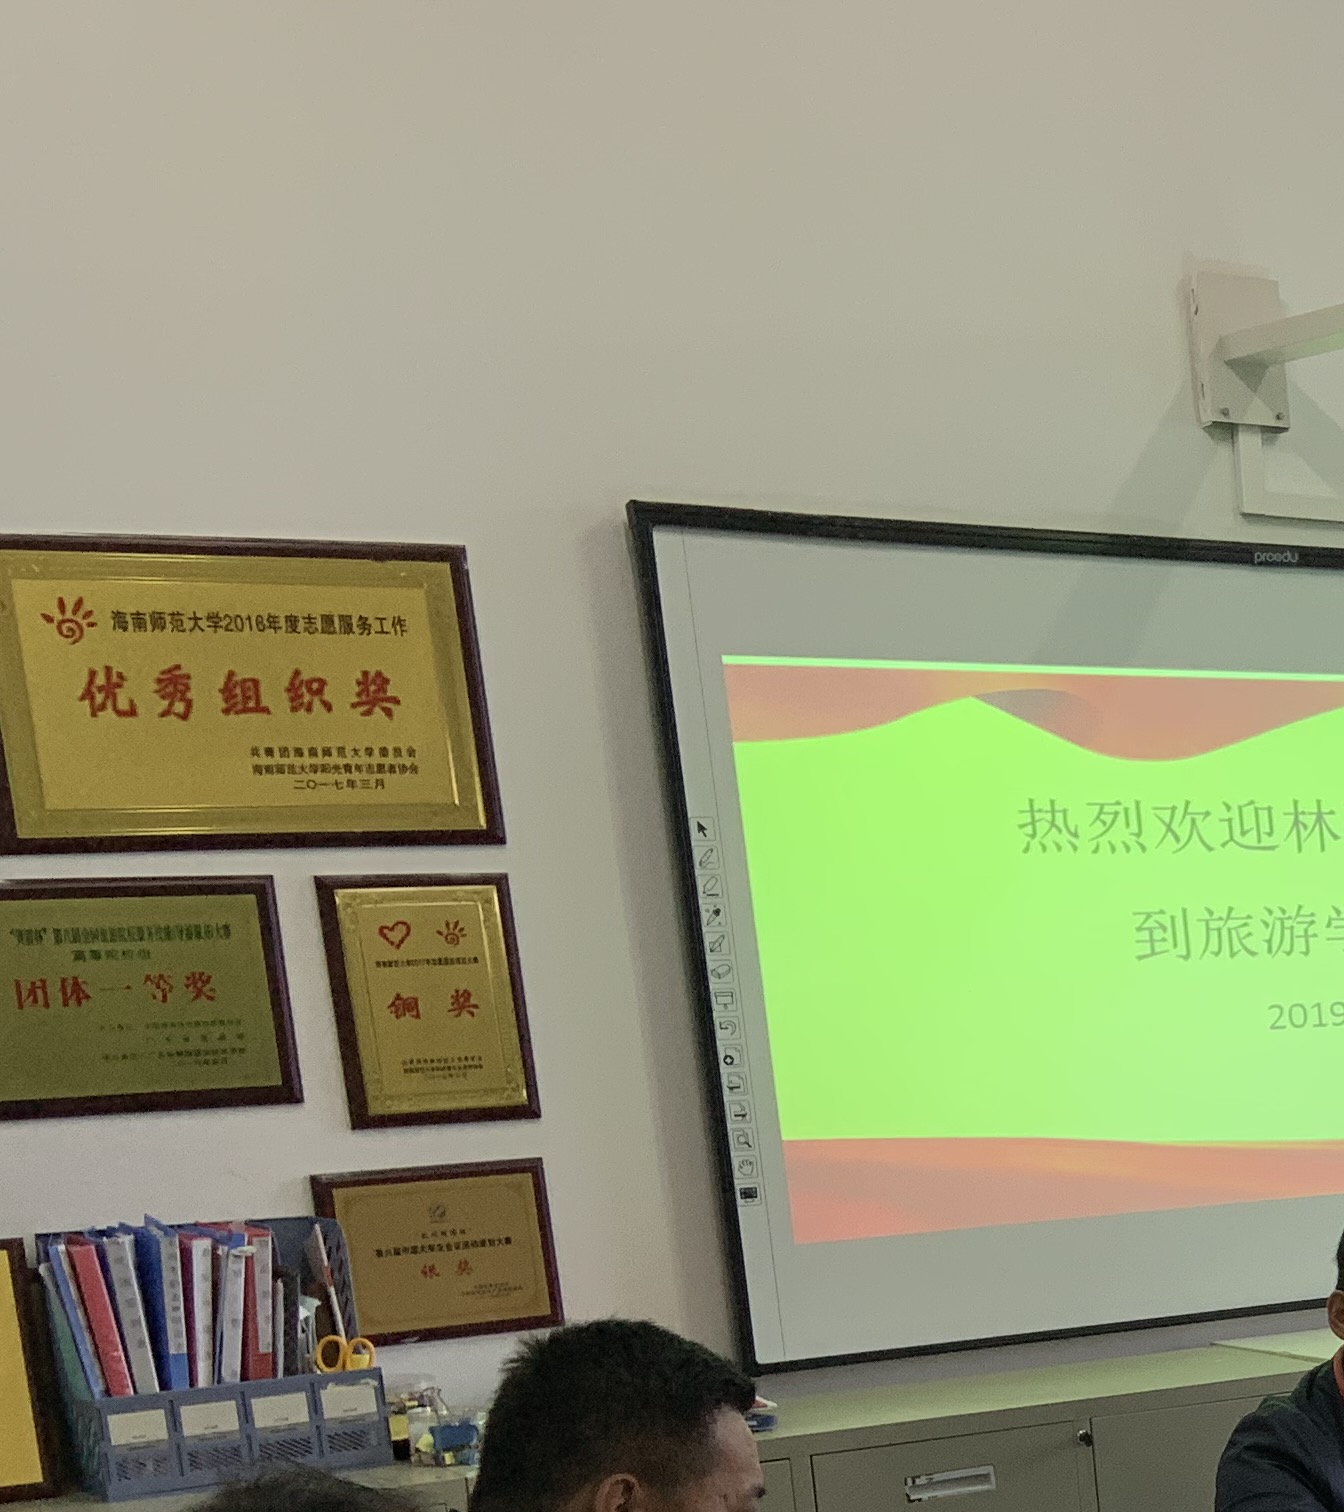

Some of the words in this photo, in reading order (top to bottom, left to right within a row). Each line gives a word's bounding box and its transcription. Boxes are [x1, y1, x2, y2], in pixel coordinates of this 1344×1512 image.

[78, 663, 402, 722] 优秀组织奖
[13, 970, 217, 1011] 团体一等奖
